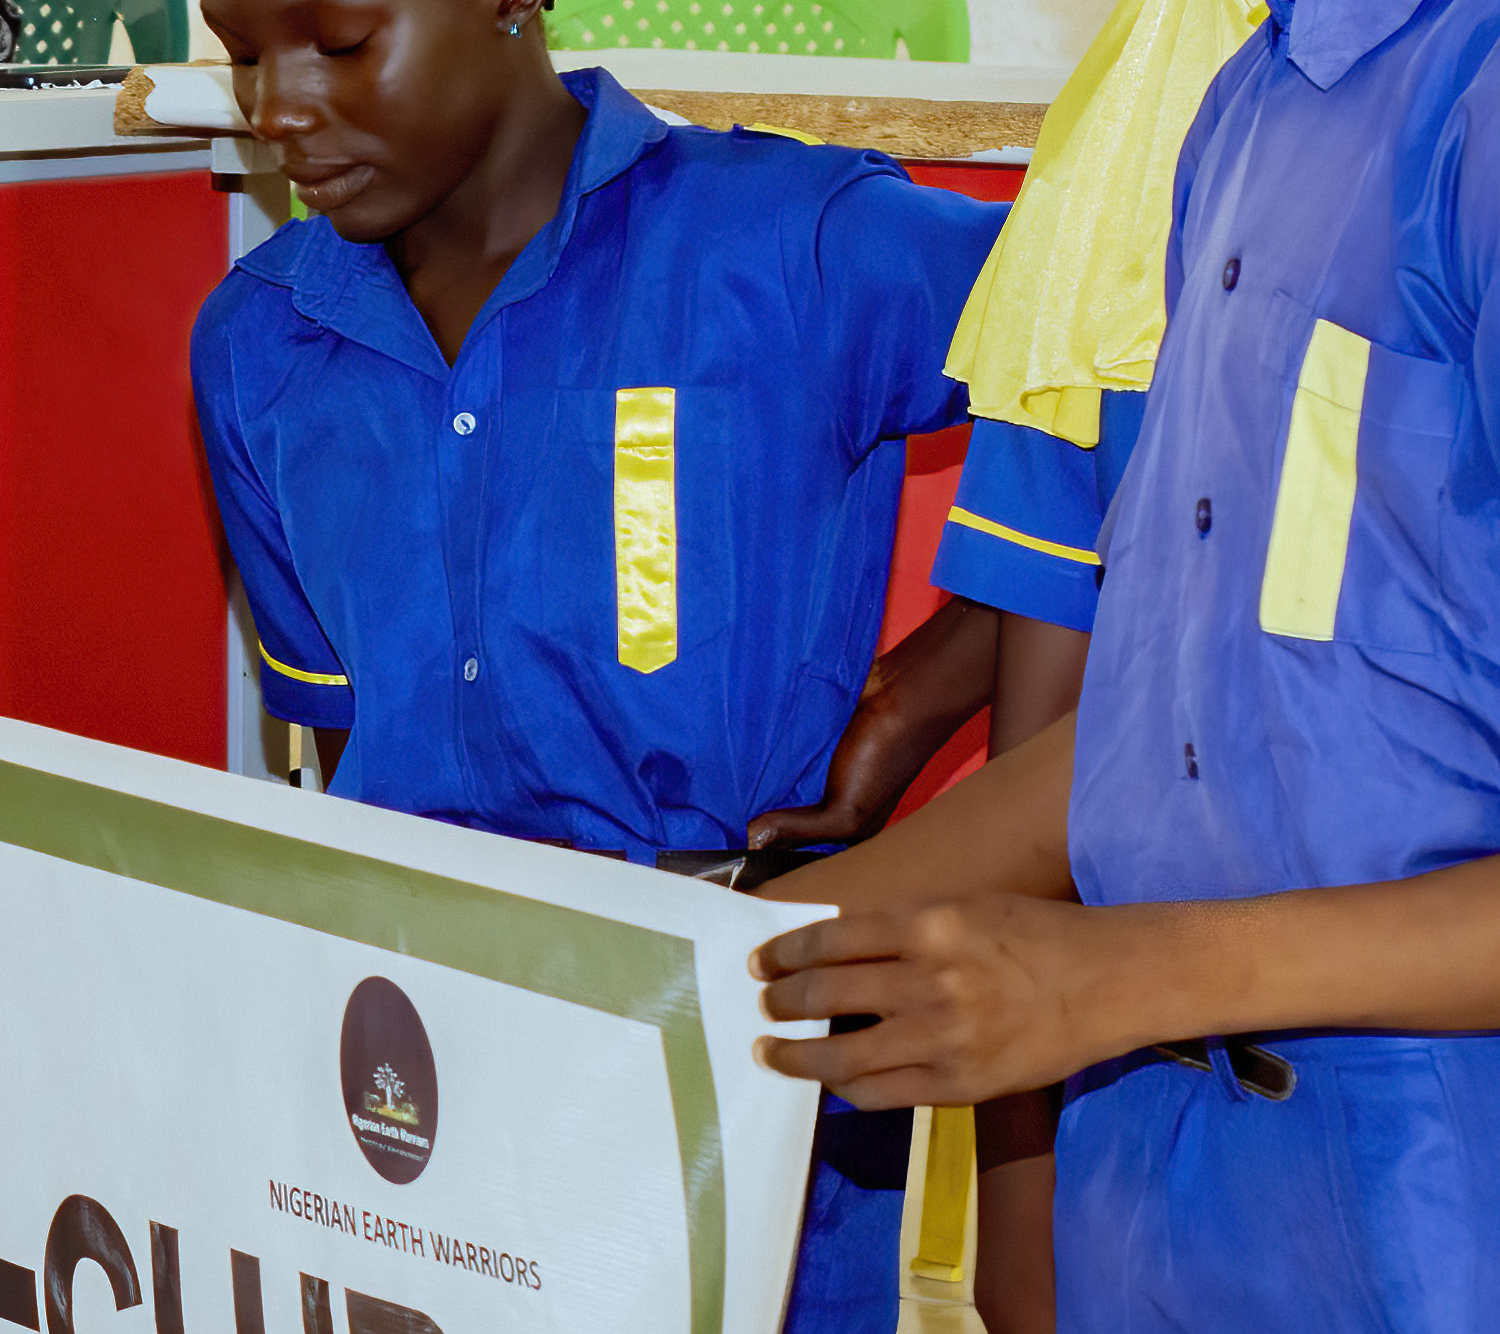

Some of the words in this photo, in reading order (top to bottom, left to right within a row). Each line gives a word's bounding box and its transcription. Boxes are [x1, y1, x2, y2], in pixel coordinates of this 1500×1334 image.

[269, 1179, 357, 1237] NIGERIAN
[362, 1211, 425, 1258] EARTH
[429, 1230, 543, 1291] WARRIORS
